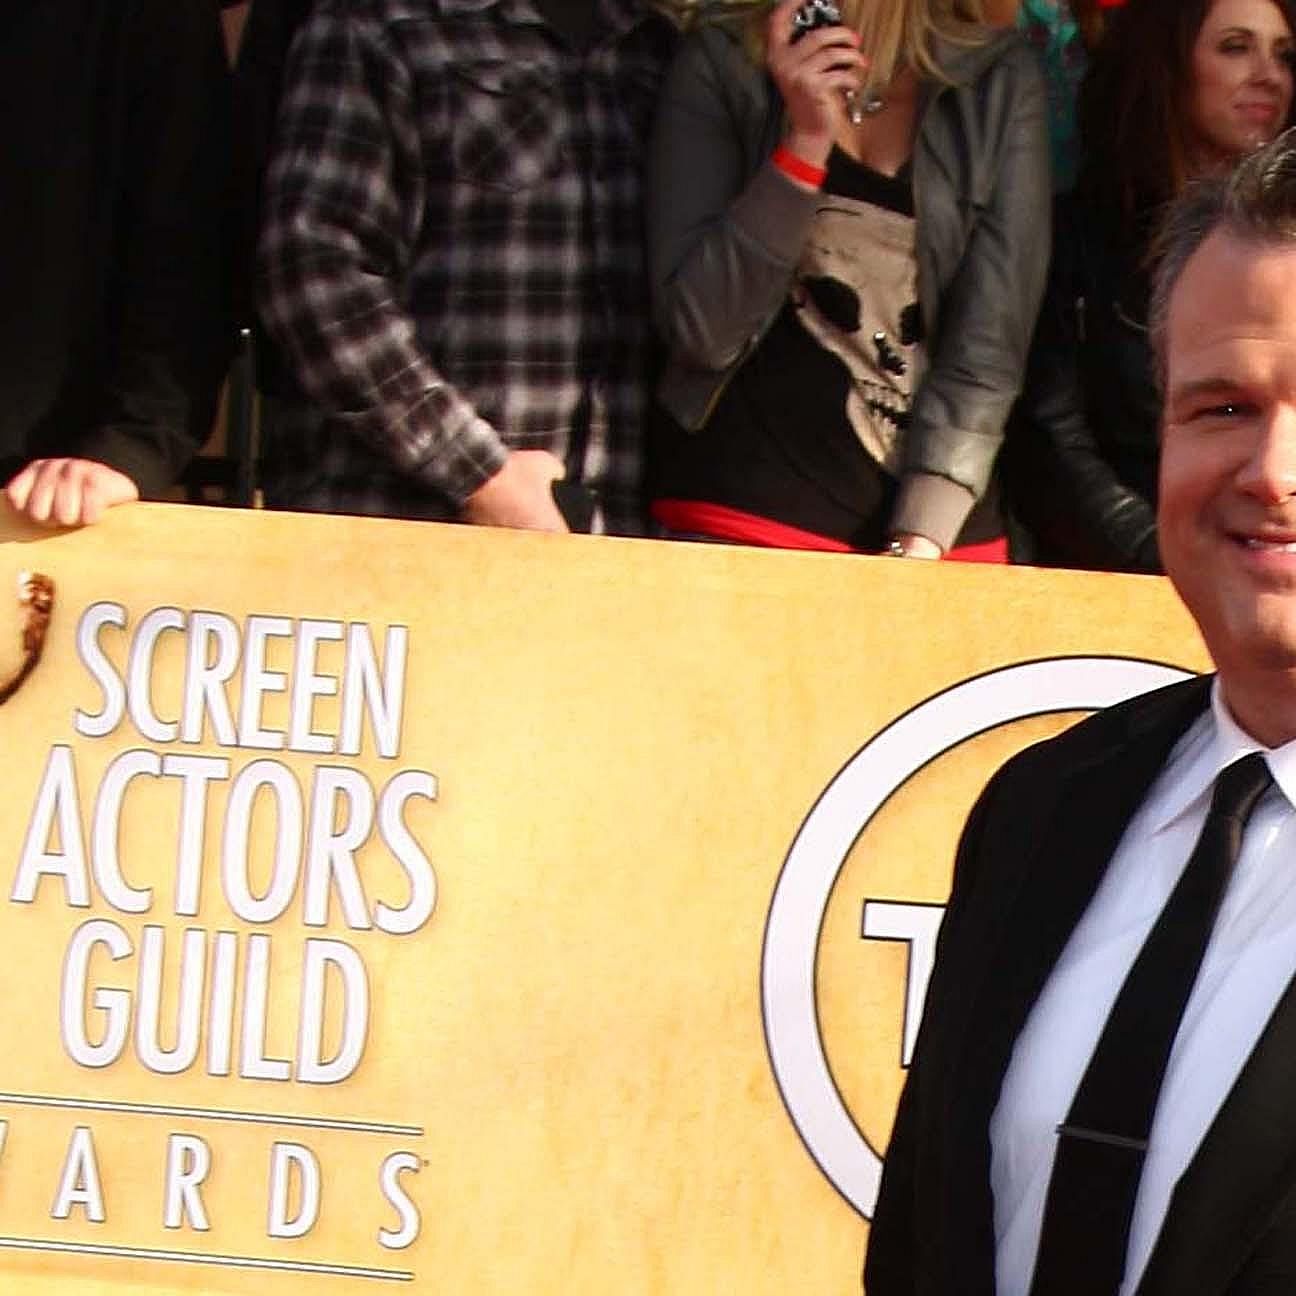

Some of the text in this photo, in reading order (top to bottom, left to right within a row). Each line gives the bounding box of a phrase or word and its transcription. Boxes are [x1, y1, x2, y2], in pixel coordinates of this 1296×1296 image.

[73, 600, 409, 759] SCREEN
[10, 743, 439, 935] ACTORS
[61, 918, 371, 1084] GUILD
[0, 1119, 424, 1250] ARDS
